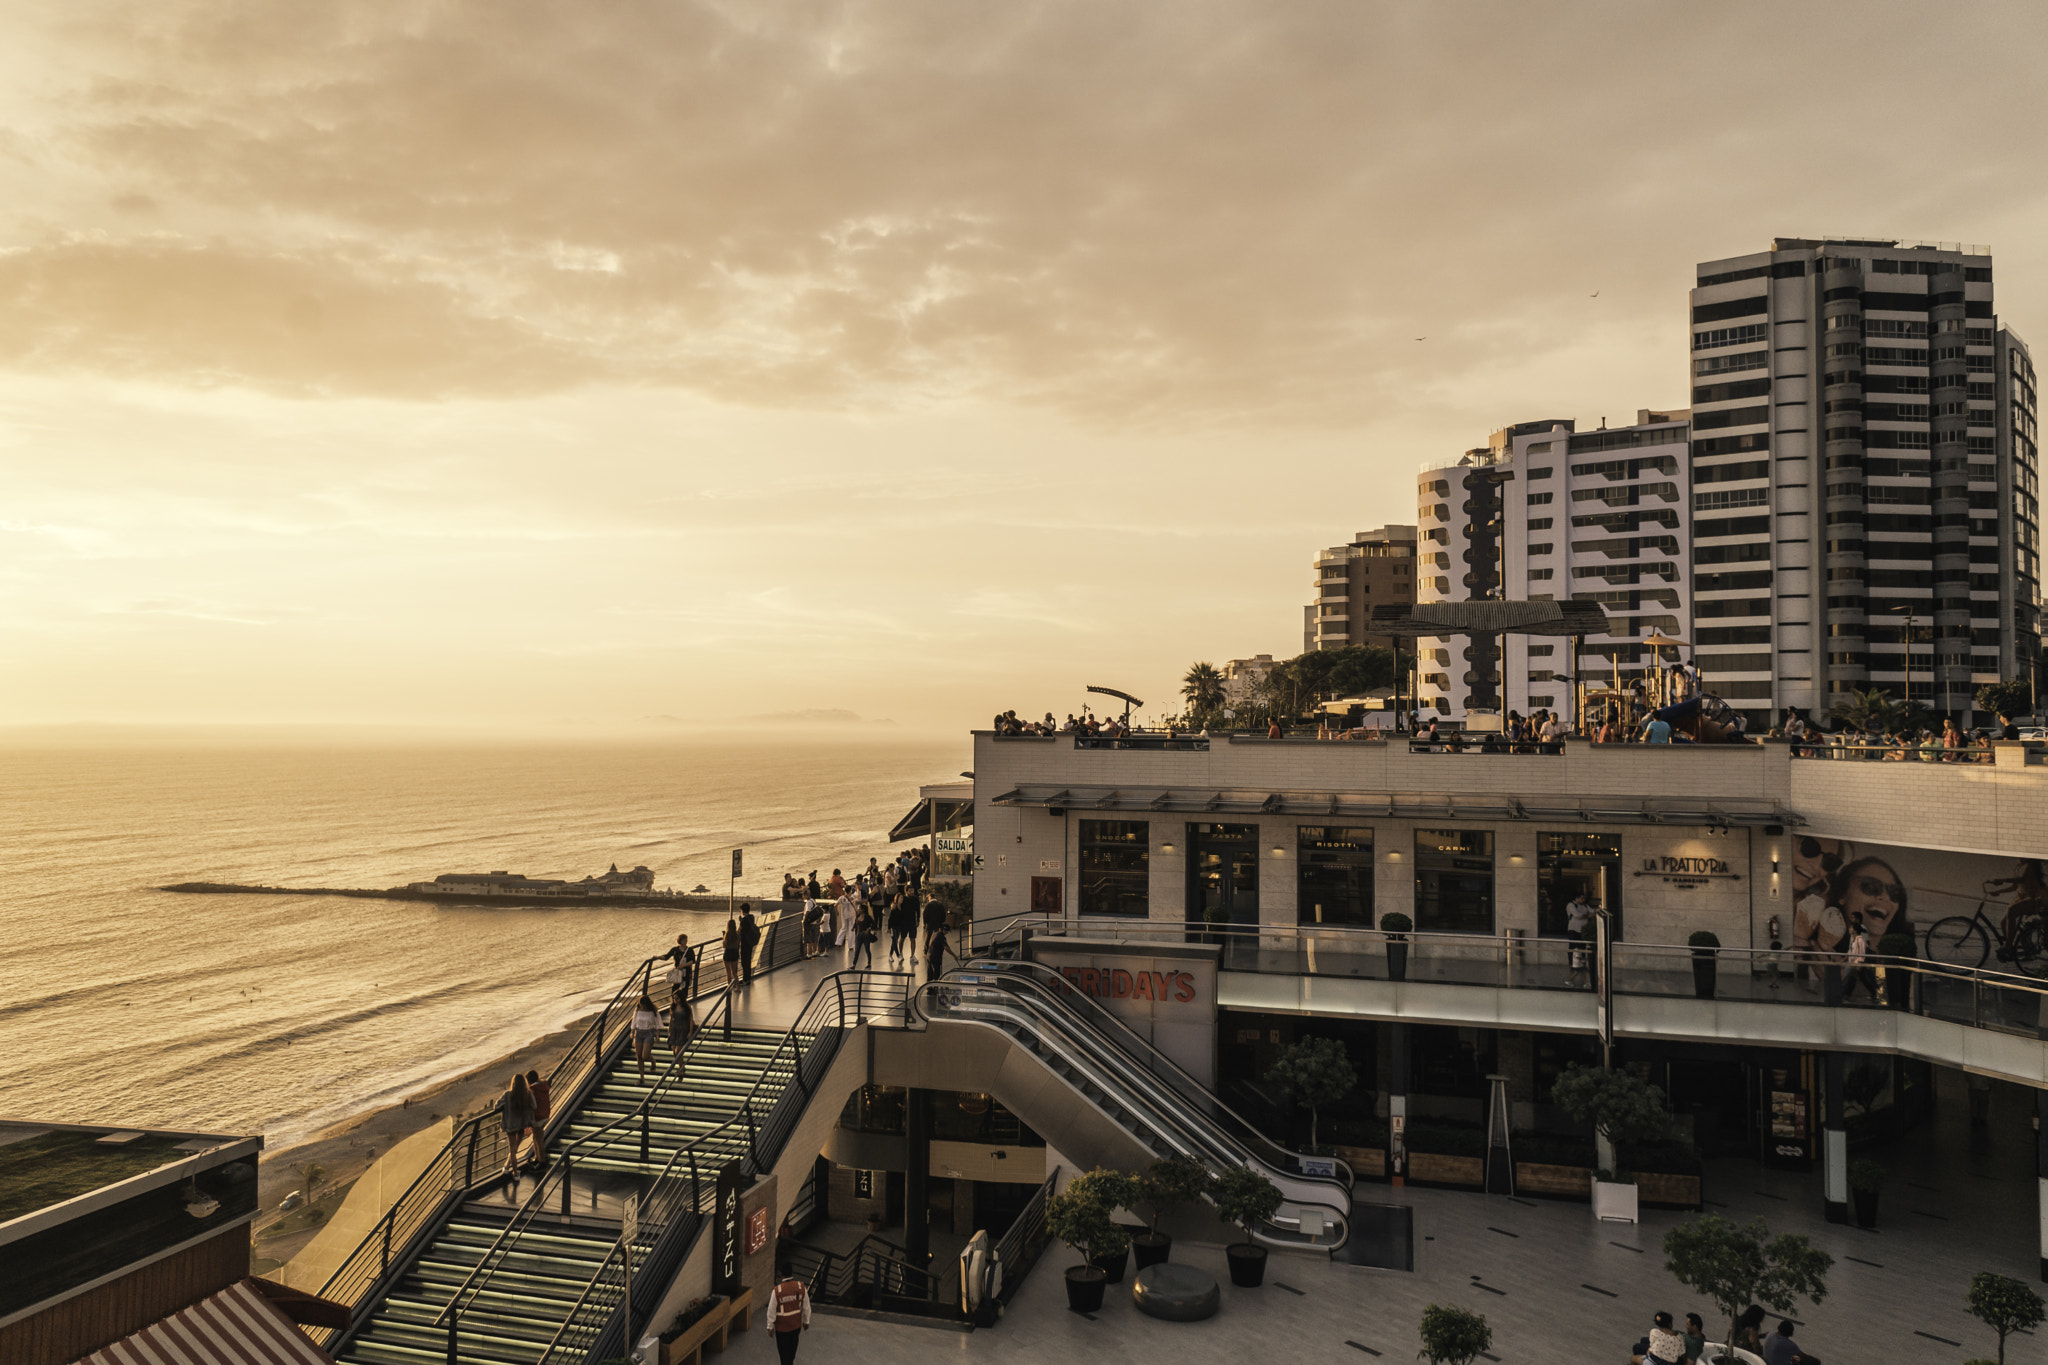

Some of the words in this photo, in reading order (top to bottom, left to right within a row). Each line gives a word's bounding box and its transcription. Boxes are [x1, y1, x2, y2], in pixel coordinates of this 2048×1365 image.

[938, 840, 966, 851] SALIDA
[1644, 859, 1657, 871] LA
[1660, 856, 1729, 873] TRATTORIA
